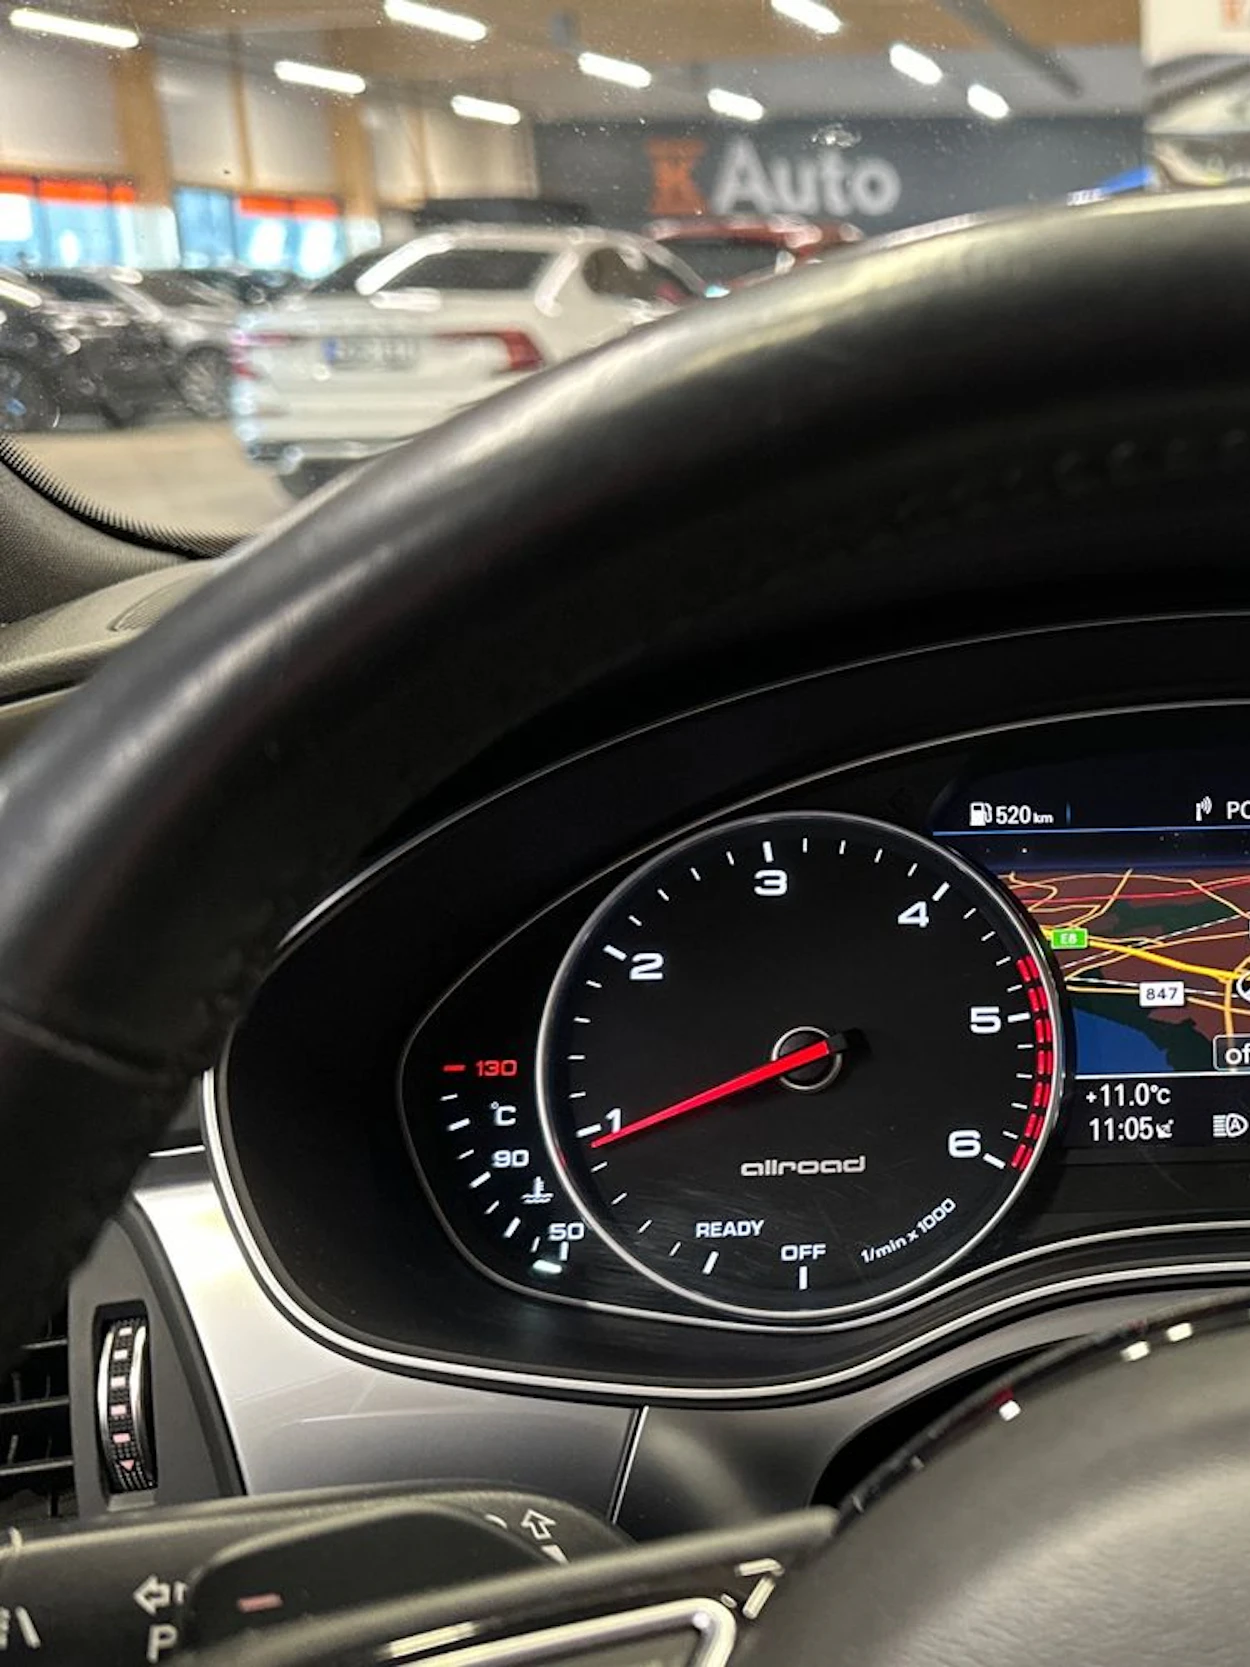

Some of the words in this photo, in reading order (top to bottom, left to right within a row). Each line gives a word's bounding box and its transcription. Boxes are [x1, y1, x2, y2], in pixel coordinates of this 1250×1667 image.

[712, 138, 900, 214] Auto
[754, 869, 788, 896] 3
[897, 902, 930, 928] 4
[630, 952, 664, 980] 2
[1145, 984, 1180, 1004] 847
[970, 1006, 1002, 1034] 5
[476, 1059, 518, 1077] 130
[605, 1105, 624, 1133] 1
[1089, 1116, 1154, 1142] 11:05
[948, 1129, 982, 1159] 6
[492, 1149, 530, 1168] 90
[740, 1155, 866, 1177] allroad
[549, 1220, 586, 1241] 50
[695, 1219, 765, 1238] READY
[780, 1243, 826, 1262] OFF
[148, 1624, 177, 1661] P
